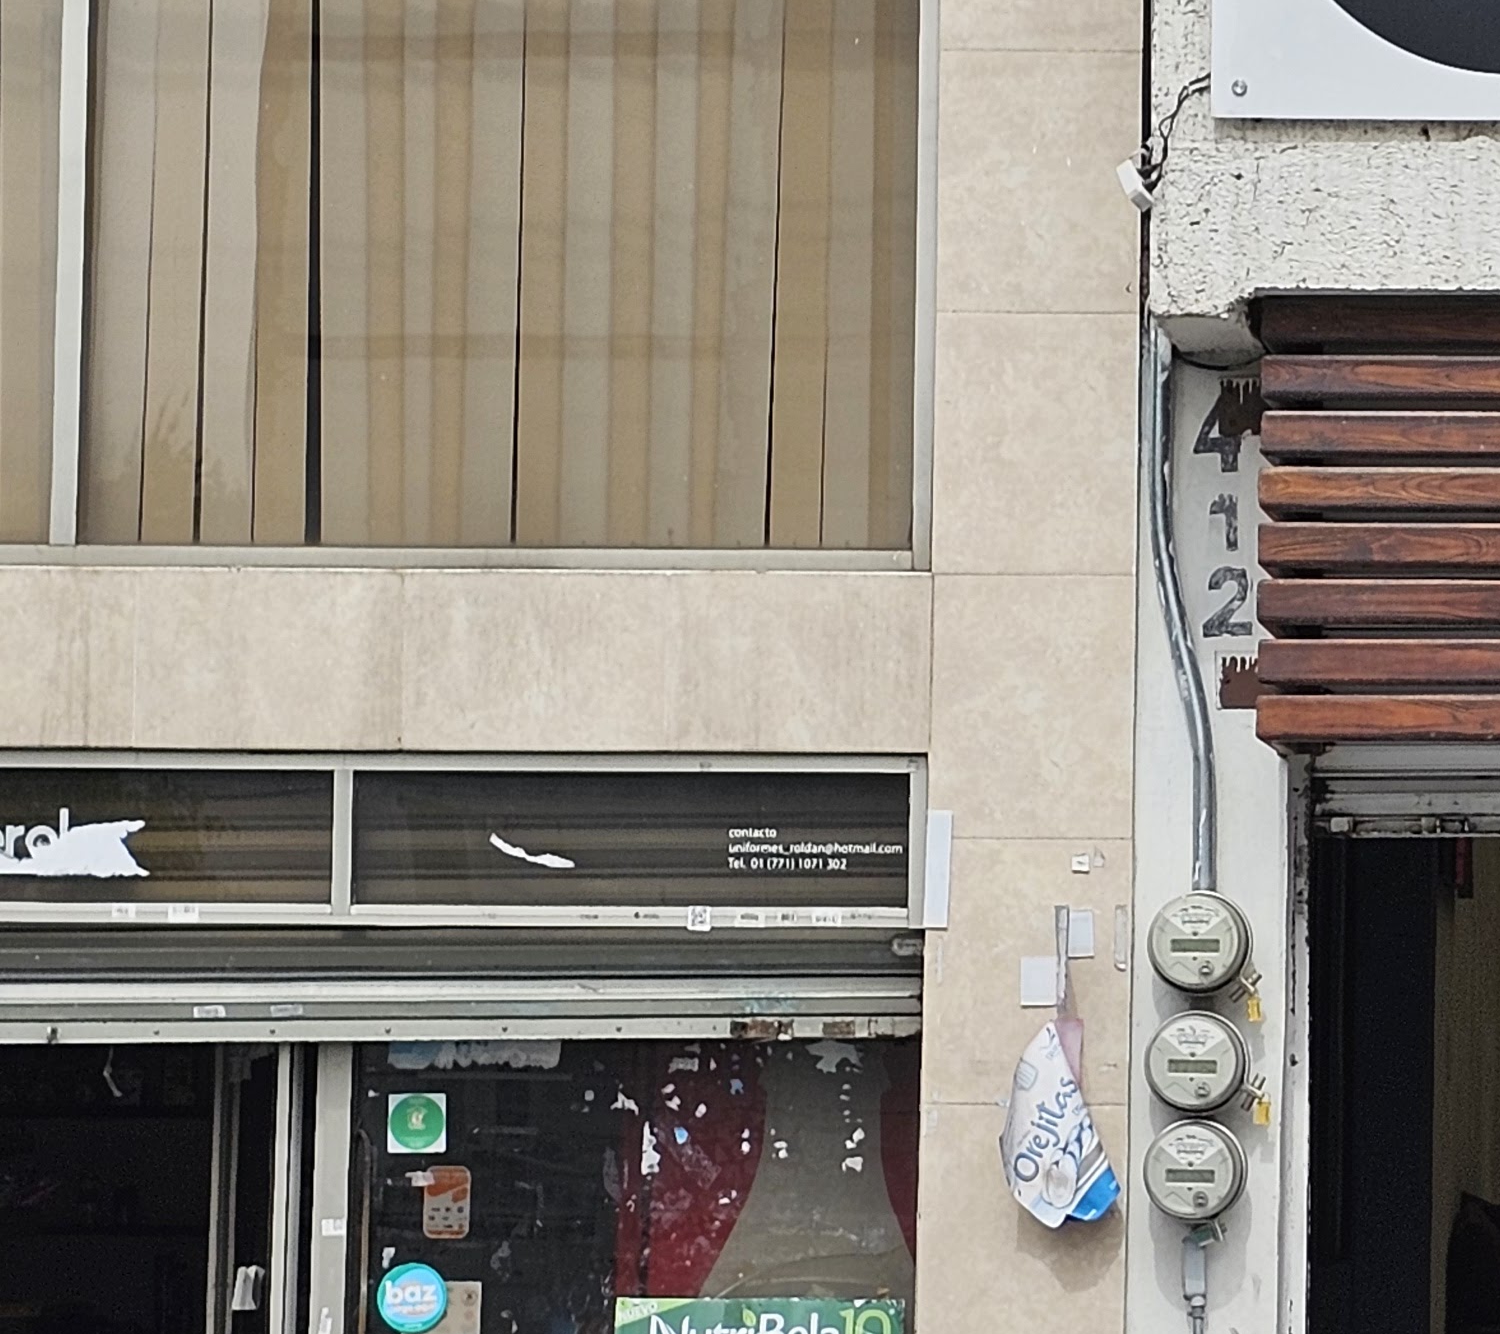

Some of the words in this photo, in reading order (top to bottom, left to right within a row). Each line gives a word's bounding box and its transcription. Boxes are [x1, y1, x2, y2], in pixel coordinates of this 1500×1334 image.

[729, 828, 778, 839] contacto
[751, 857, 764, 869] 01
[767, 857, 795, 871] (771)
[799, 857, 823, 870] 1071
[827, 857, 847, 870] 302
[1013, 1076, 1079, 1183] Orejitas
[385, 1279, 437, 1304] baz
